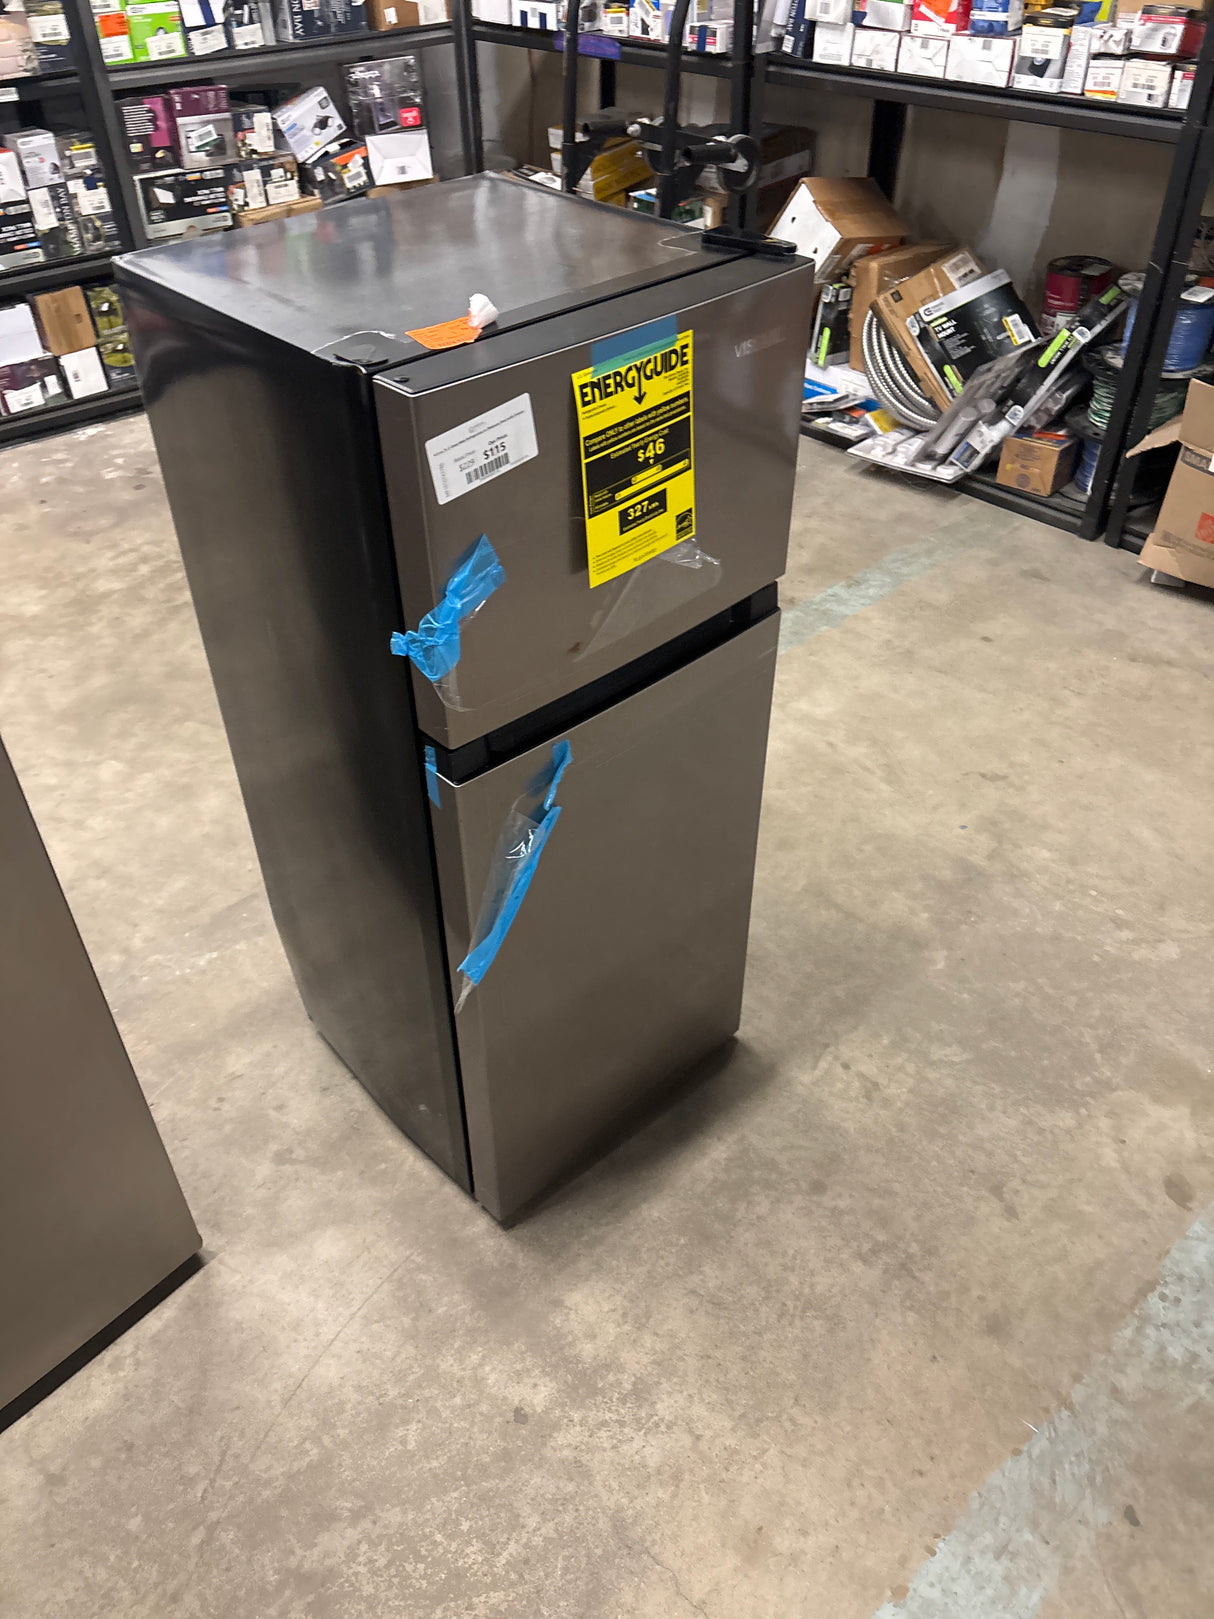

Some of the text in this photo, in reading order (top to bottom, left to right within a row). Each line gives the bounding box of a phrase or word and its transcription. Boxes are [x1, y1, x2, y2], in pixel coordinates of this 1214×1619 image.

[578, 343, 689, 408] ENERGYGUIDE
[483, 441, 507, 460] $115
[637, 438, 666, 462] $46
[627, 501, 649, 520] 327
